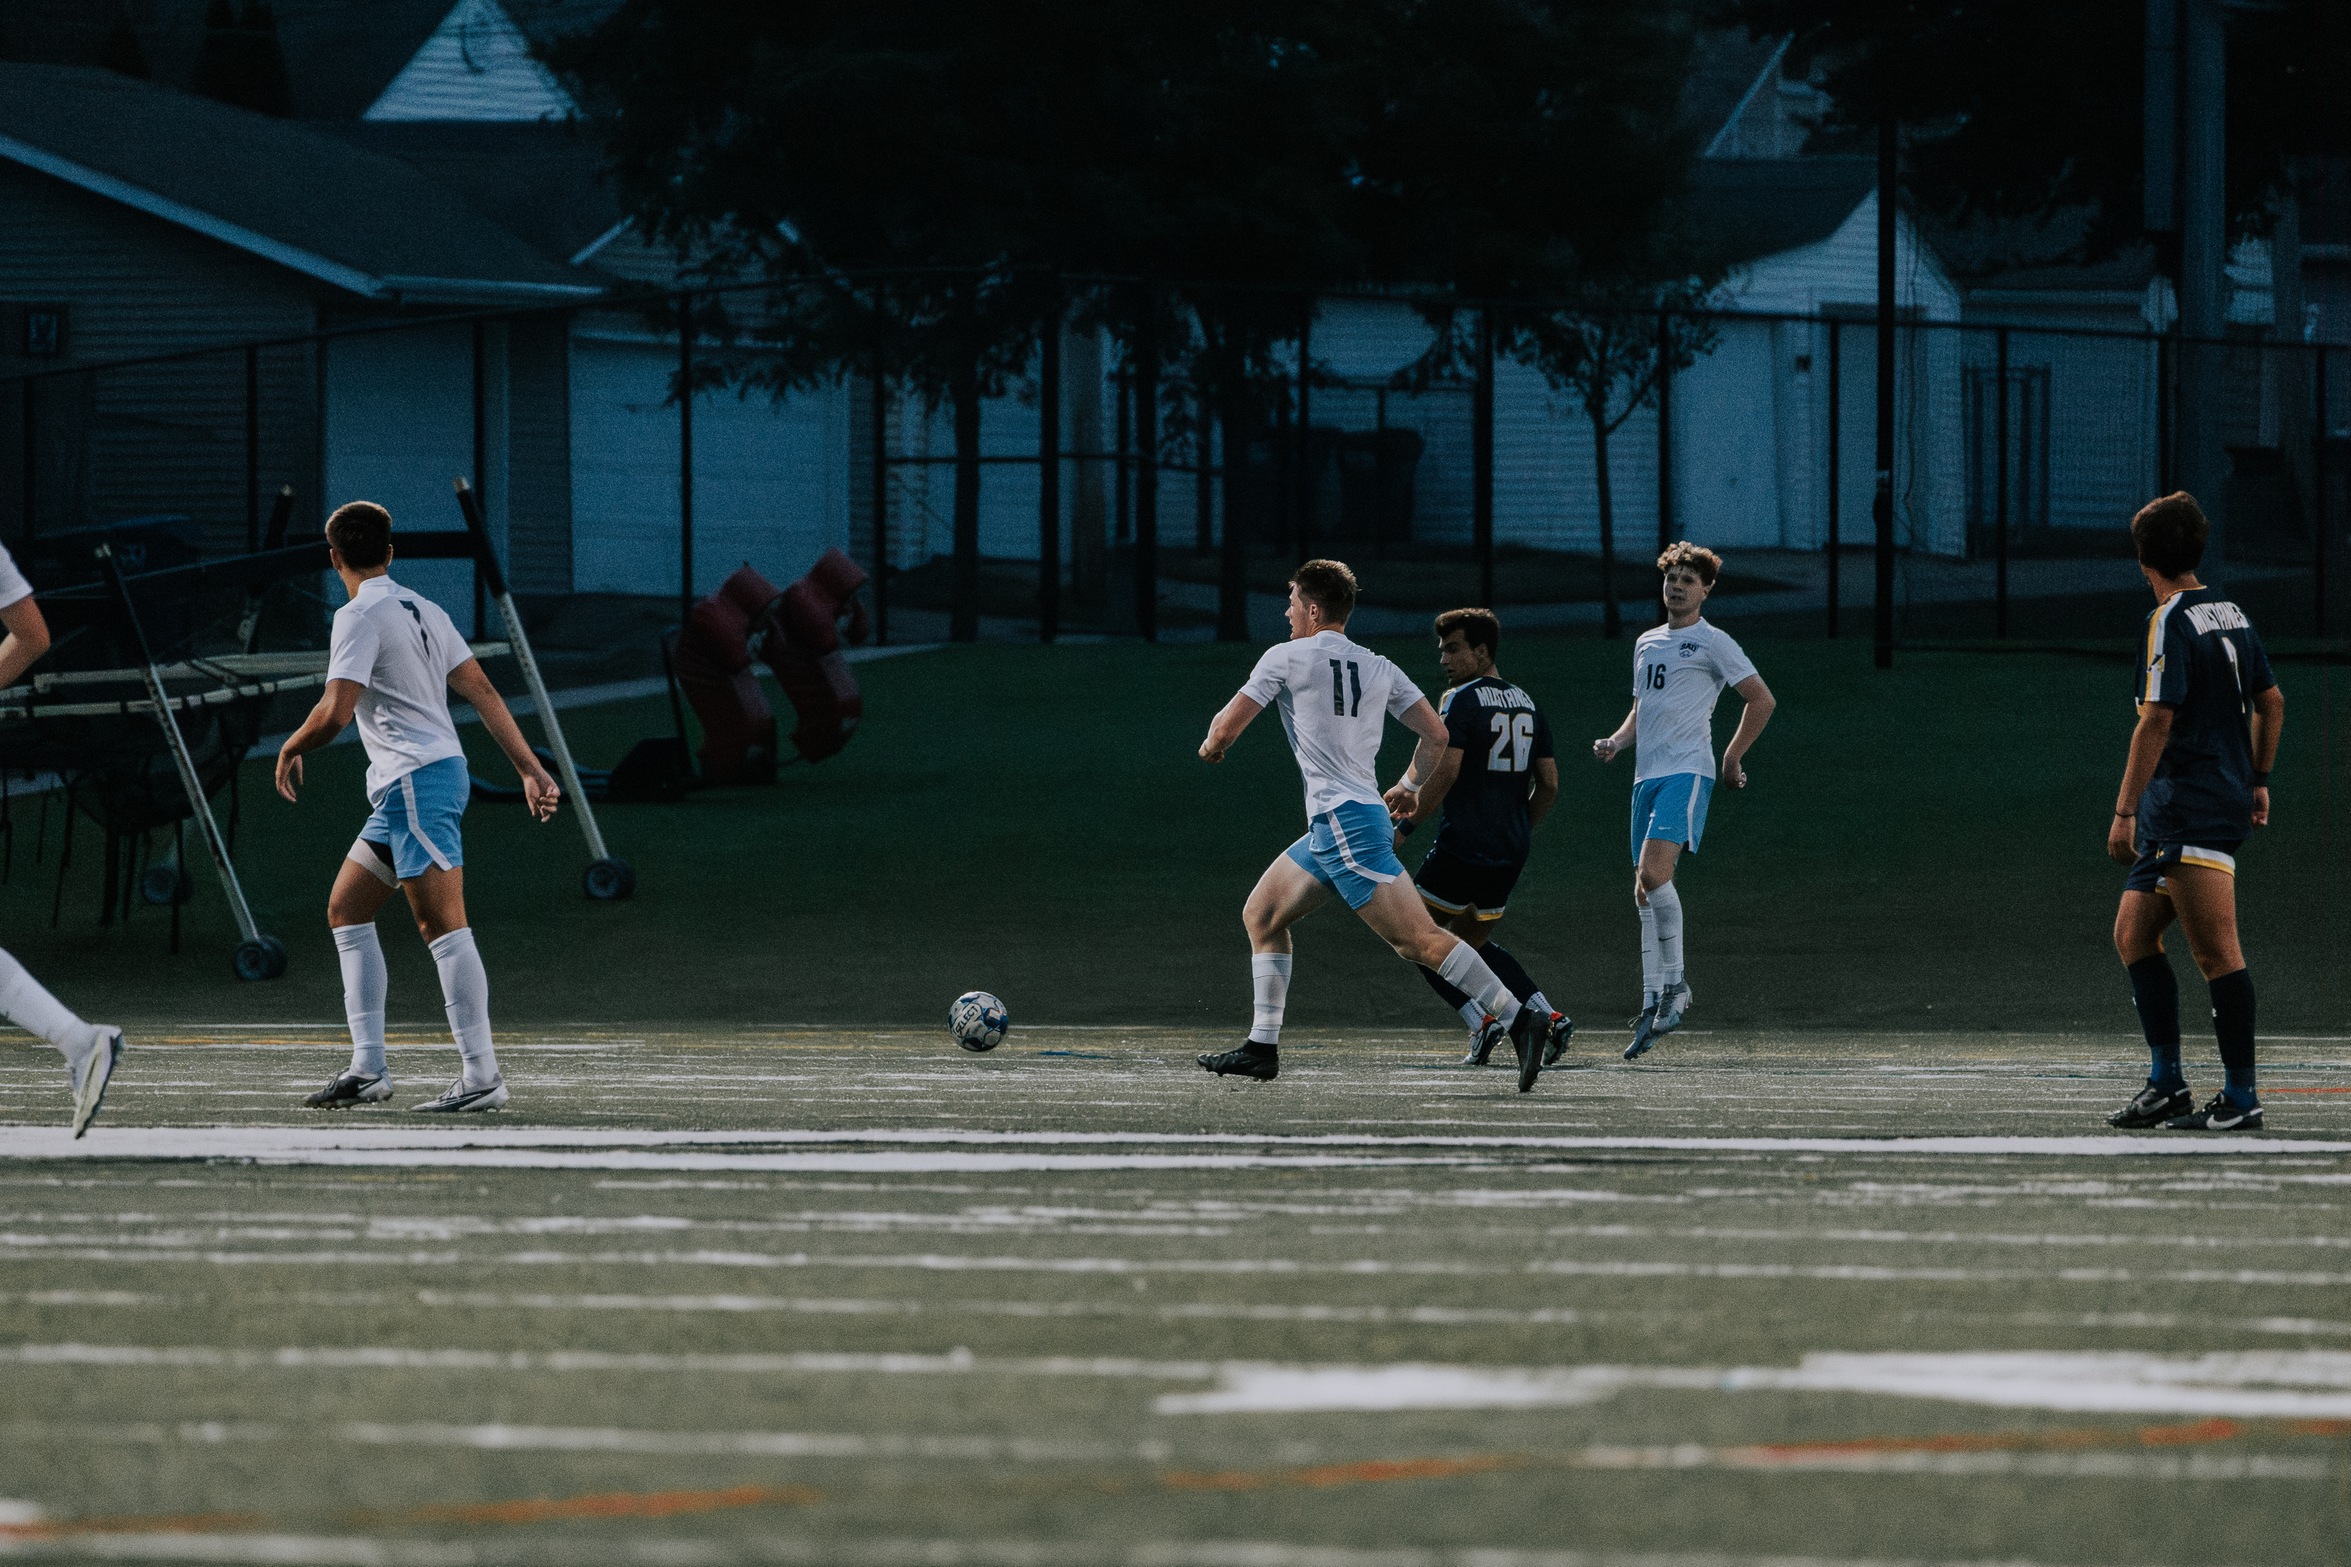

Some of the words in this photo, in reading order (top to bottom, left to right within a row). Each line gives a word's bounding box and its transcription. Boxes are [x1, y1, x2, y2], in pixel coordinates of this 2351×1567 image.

[1328, 658, 1362, 718] 11
[1646, 663, 1667, 691] 16
[1474, 686, 1536, 712] MUSTANGS
[1487, 712, 1534, 772] 26
[955, 1005, 978, 1036] SELECT
